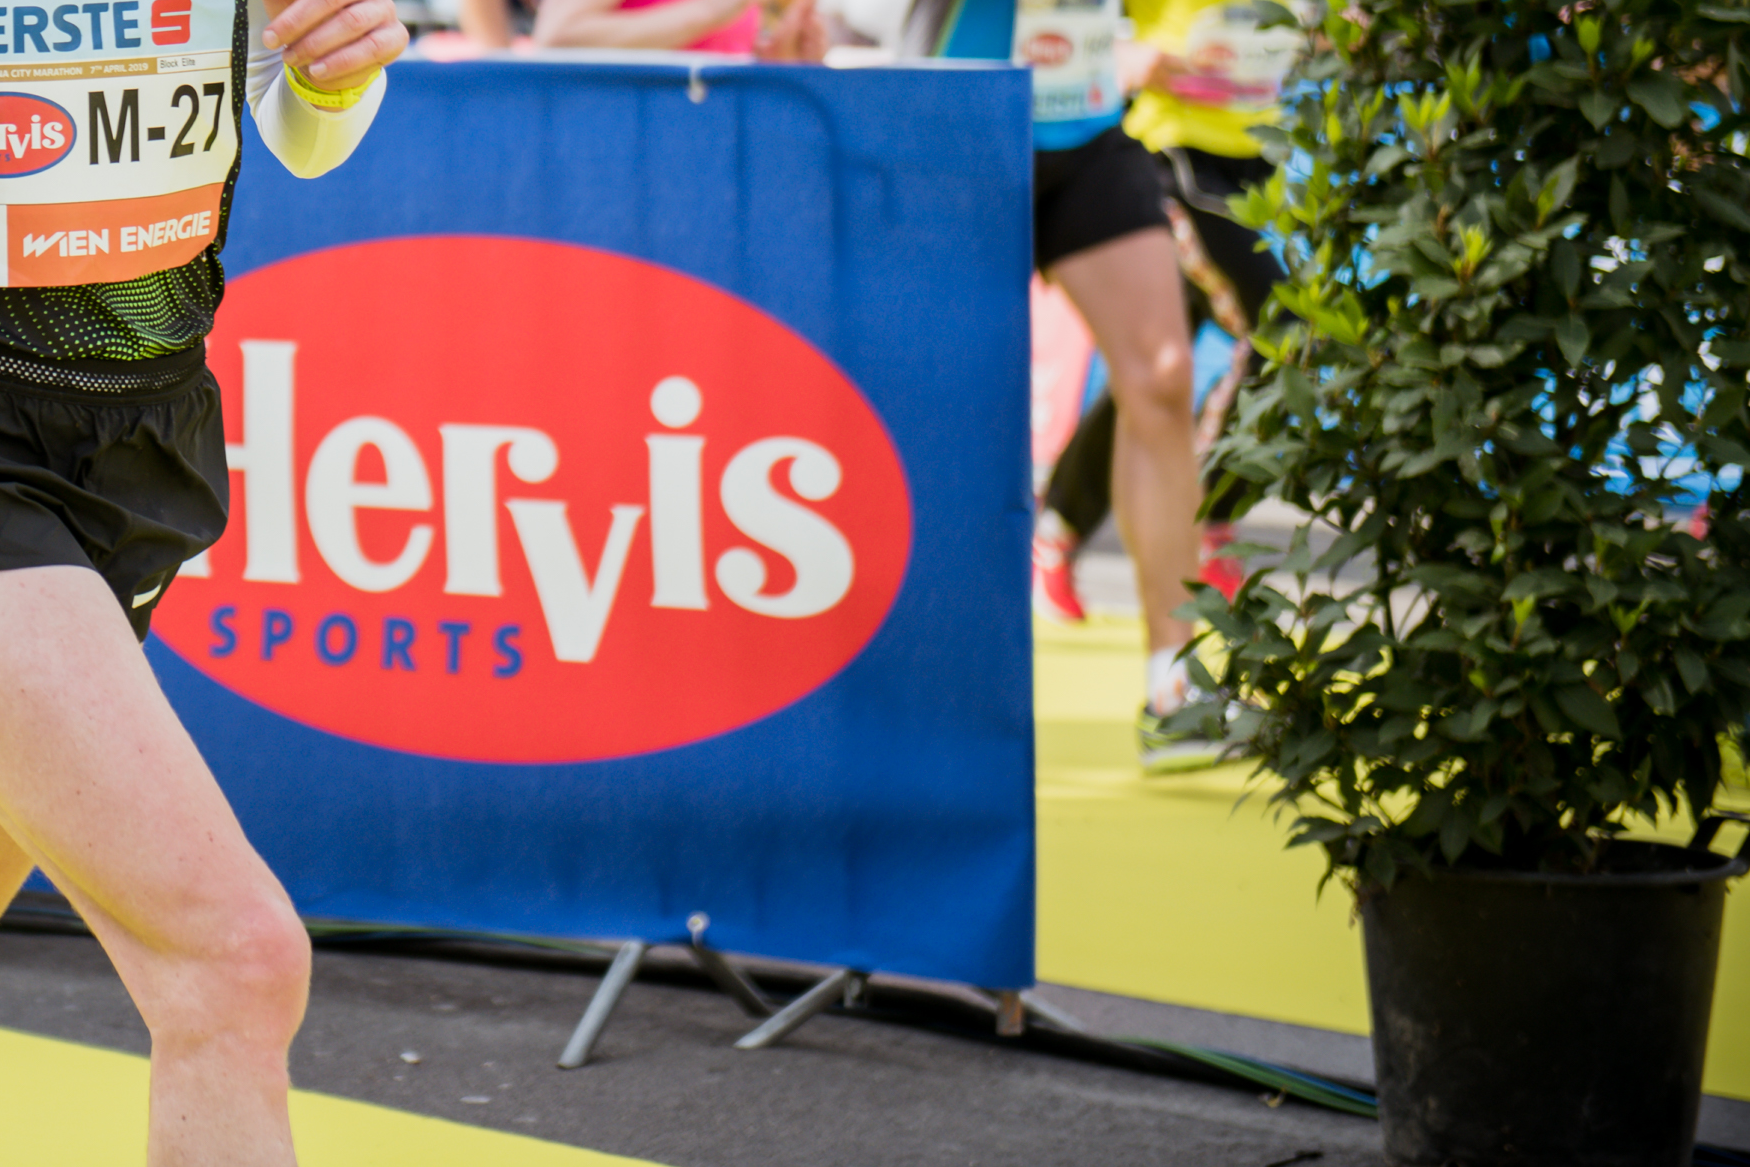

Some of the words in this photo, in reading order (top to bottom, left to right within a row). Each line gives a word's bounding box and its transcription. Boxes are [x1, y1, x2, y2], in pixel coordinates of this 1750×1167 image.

[10, 68, 32, 78] CITY
[32, 66, 83, 77] MARATHON
[103, 63, 127, 74] APRIL
[127, 62, 149, 73] 2019
[159, 59, 179, 69] Block
[88, 81, 226, 166] M-27
[23, 228, 110, 258] WIEN
[120, 210, 212, 253] ENERGIE
[208, 605, 527, 679] SPORTS
